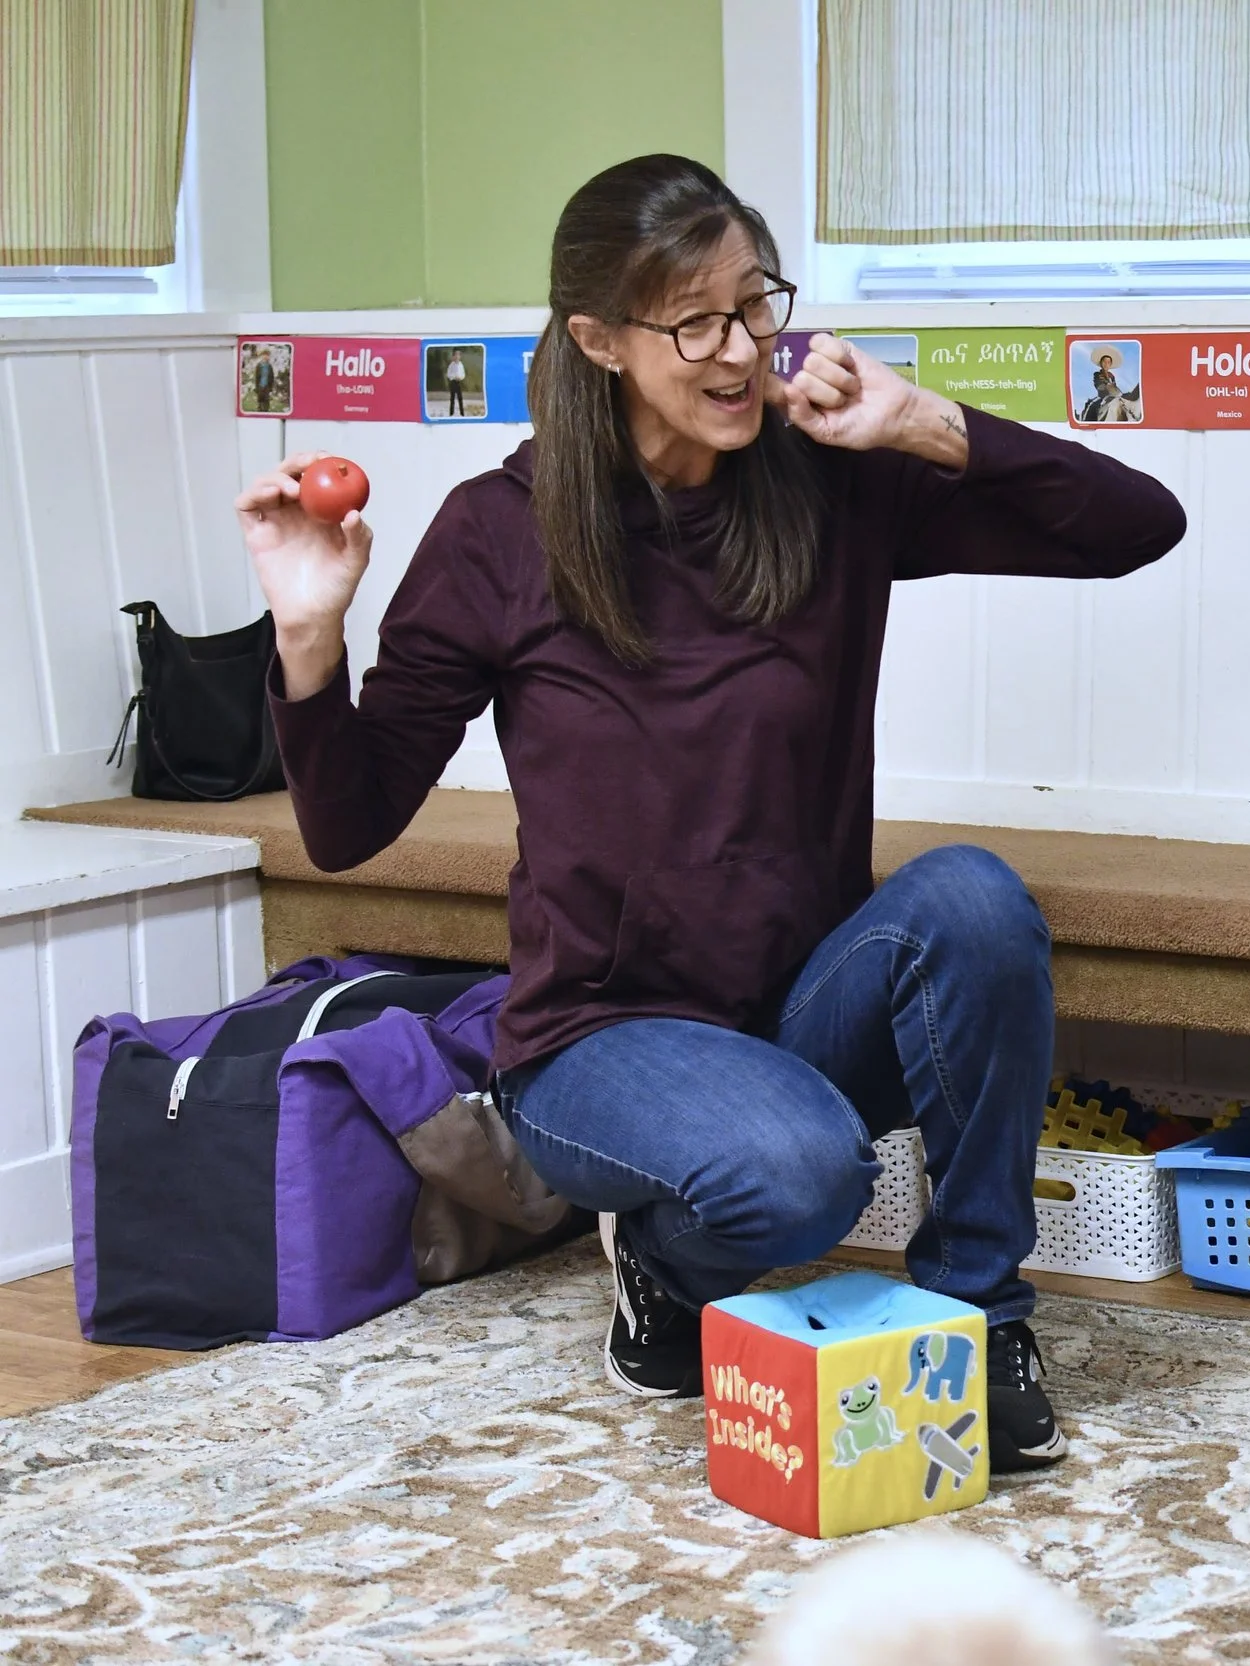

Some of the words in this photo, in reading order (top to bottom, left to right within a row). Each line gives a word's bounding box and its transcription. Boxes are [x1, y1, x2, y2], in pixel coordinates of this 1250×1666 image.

[325, 348, 386, 378] Hallo
[946, 379, 1037, 391] (tyeh-NESS-teh-ling)
[1205, 386, 1248, 398] (OHL-la)
[1216, 410, 1243, 418] Mexico
[710, 1364, 793, 1431] What's
[708, 1408, 804, 1485] Inside?
